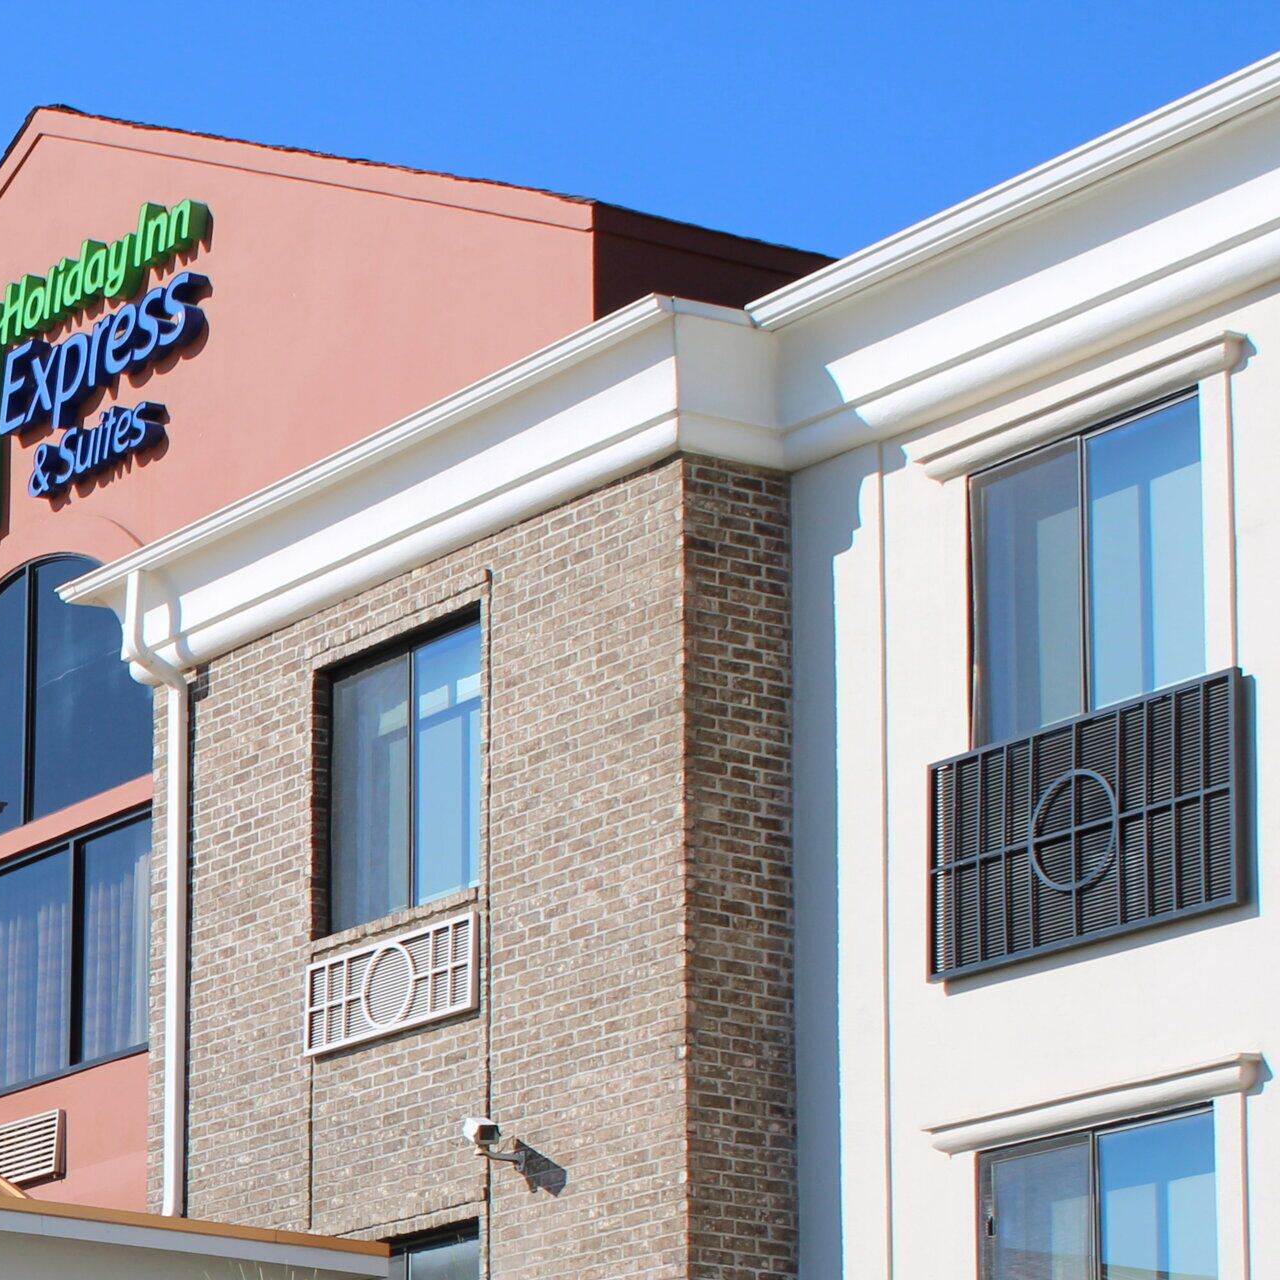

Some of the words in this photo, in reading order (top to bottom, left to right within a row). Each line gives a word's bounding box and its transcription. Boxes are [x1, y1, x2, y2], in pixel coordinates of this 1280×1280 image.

[133, 199, 194, 268] Inn
[27, 443, 51, 498] &
[55, 401, 148, 485] Suites
